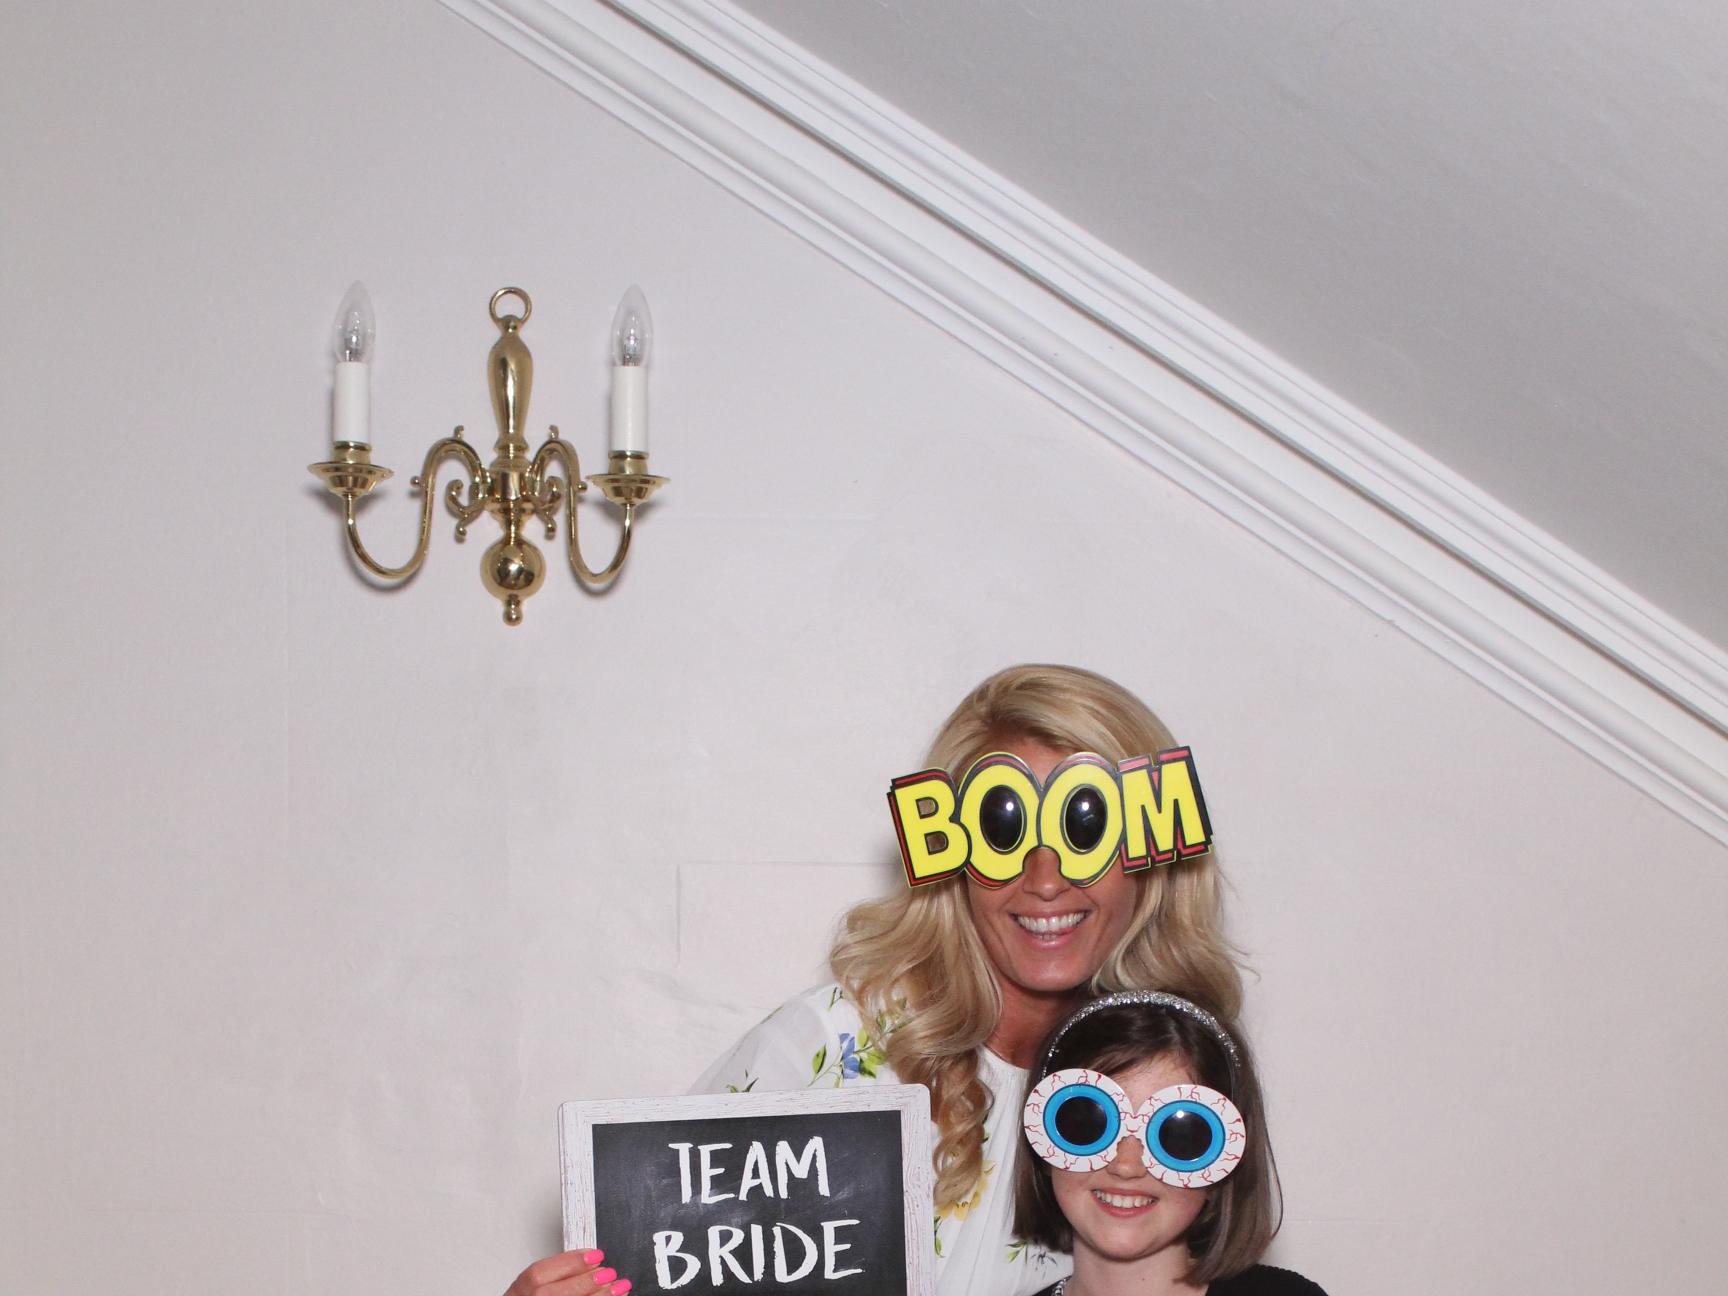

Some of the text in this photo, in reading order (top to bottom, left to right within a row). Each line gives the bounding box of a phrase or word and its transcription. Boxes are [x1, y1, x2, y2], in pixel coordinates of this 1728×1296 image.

[889, 747, 1212, 887] BOOM
[667, 1135, 831, 1205] TEAM
[652, 1219, 866, 1290] BRIDE
